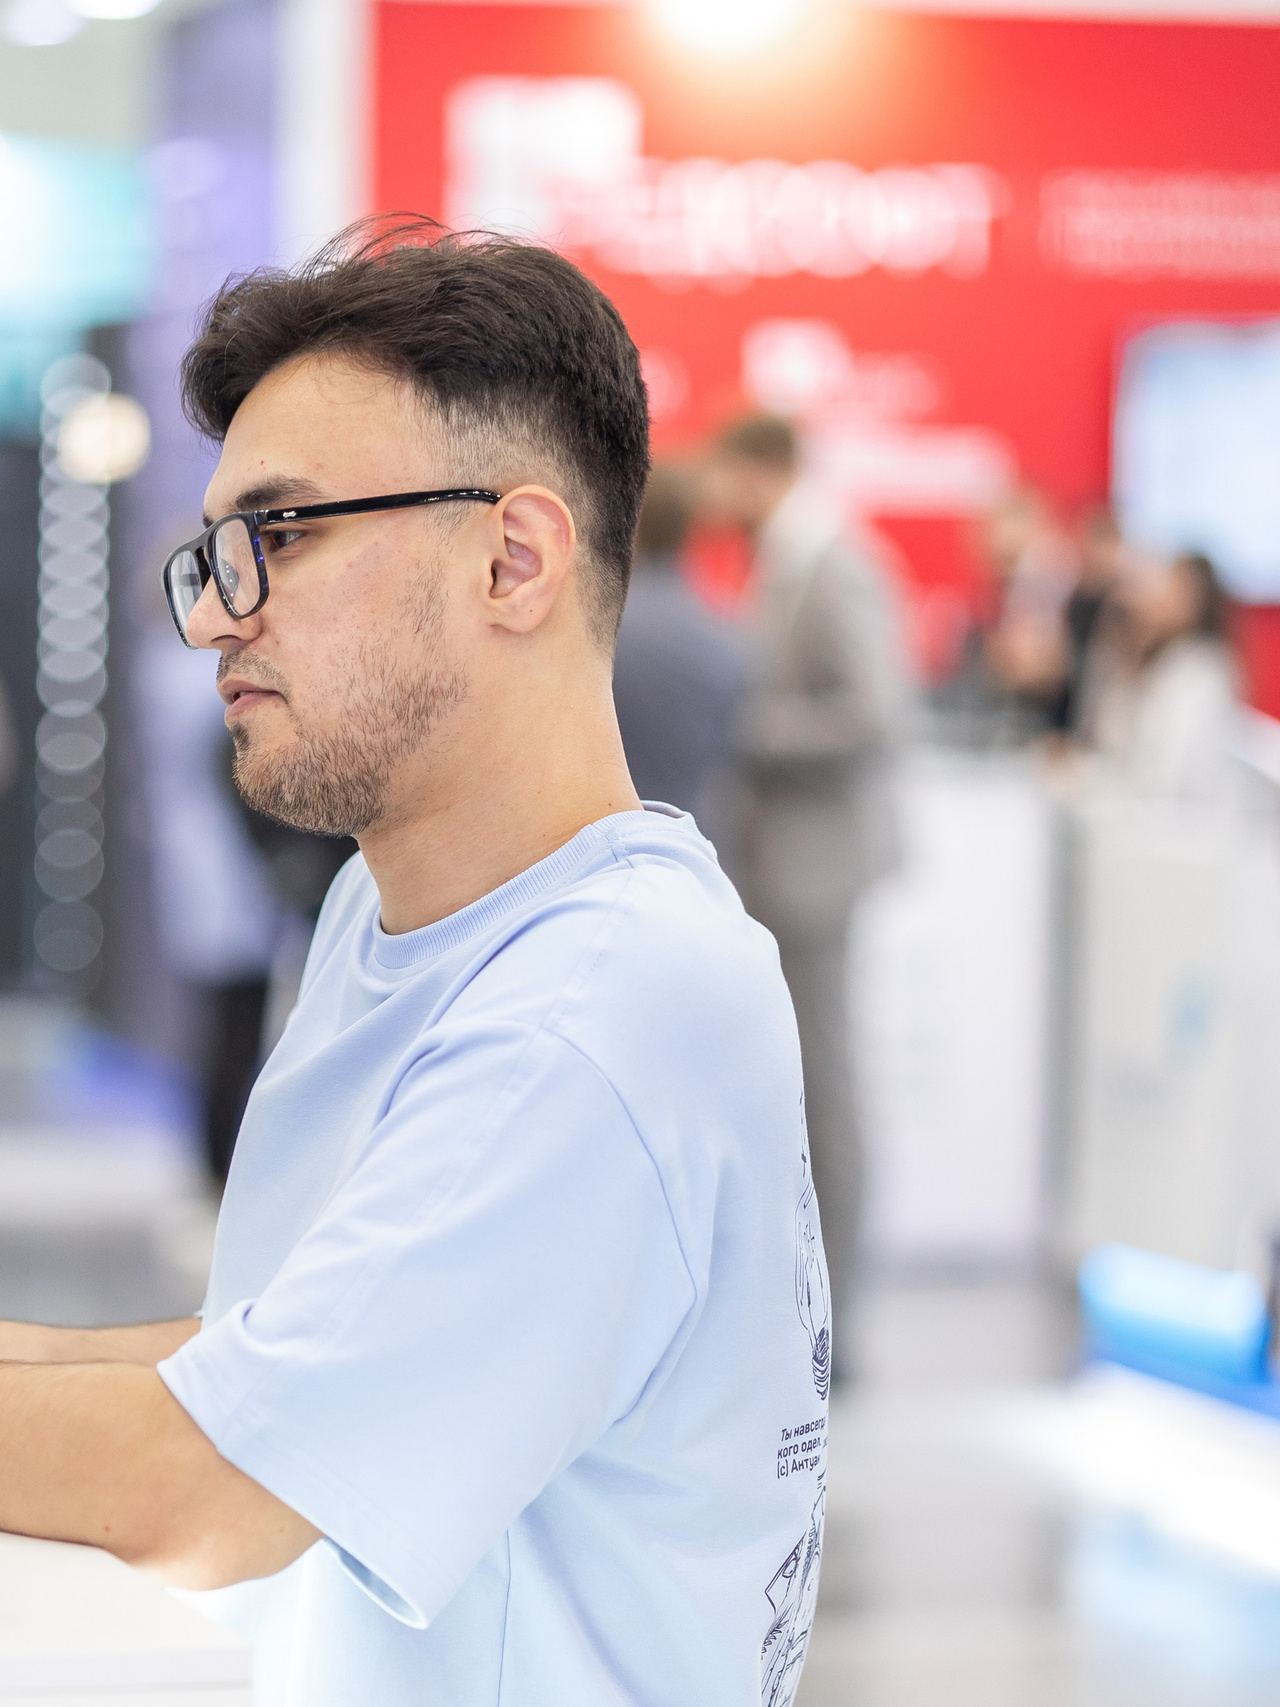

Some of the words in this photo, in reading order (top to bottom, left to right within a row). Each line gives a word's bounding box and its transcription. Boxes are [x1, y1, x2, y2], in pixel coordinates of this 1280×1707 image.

[781, 1427, 793, 1442] Ты
[793, 1416, 826, 1437] навсегд
[777, 1443, 799, 1459] кого
